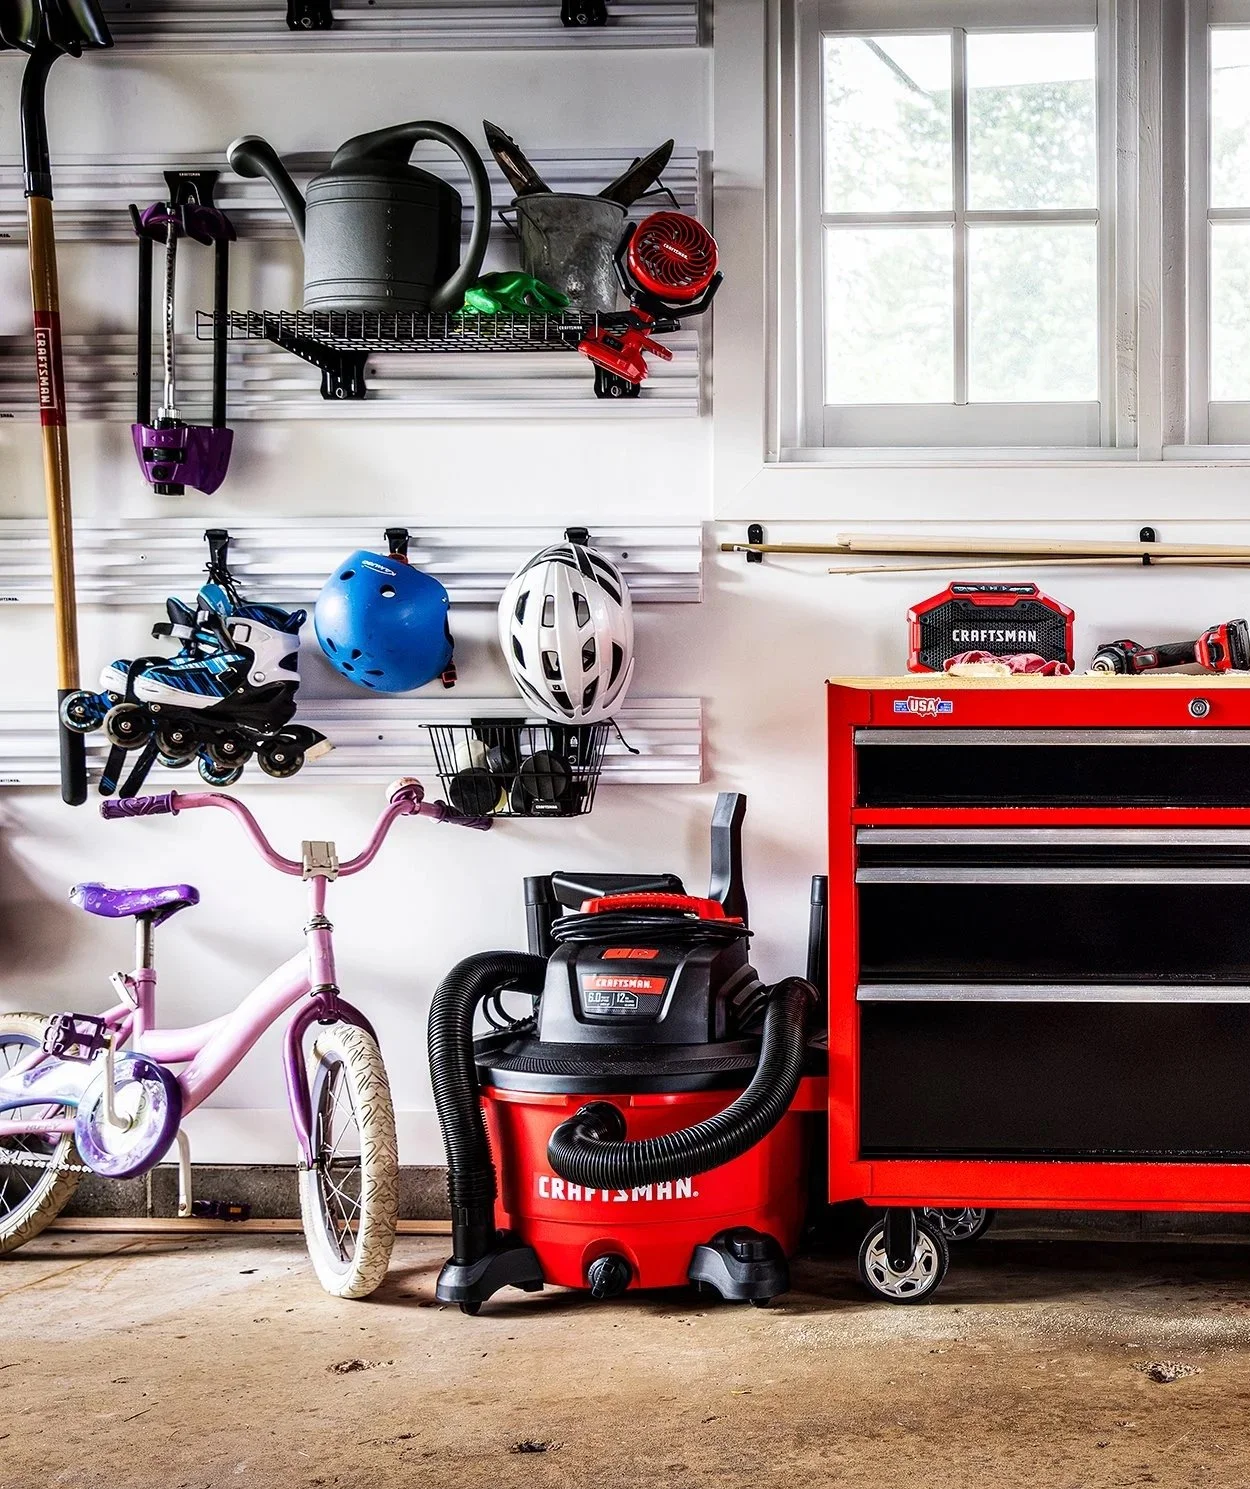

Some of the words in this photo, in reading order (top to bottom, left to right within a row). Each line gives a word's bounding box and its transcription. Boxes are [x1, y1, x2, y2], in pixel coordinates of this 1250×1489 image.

[663, 243, 688, 260] CRAFTSMAN
[36, 332, 51, 403] CRAFTSMAN
[953, 629, 1037, 643] CRAFTSMAN
[910, 700, 936, 712] USA
[595, 979, 650, 989] CRAFTSMAN
[588, 992, 602, 1003] 6.0
[616, 993, 626, 1003] 12
